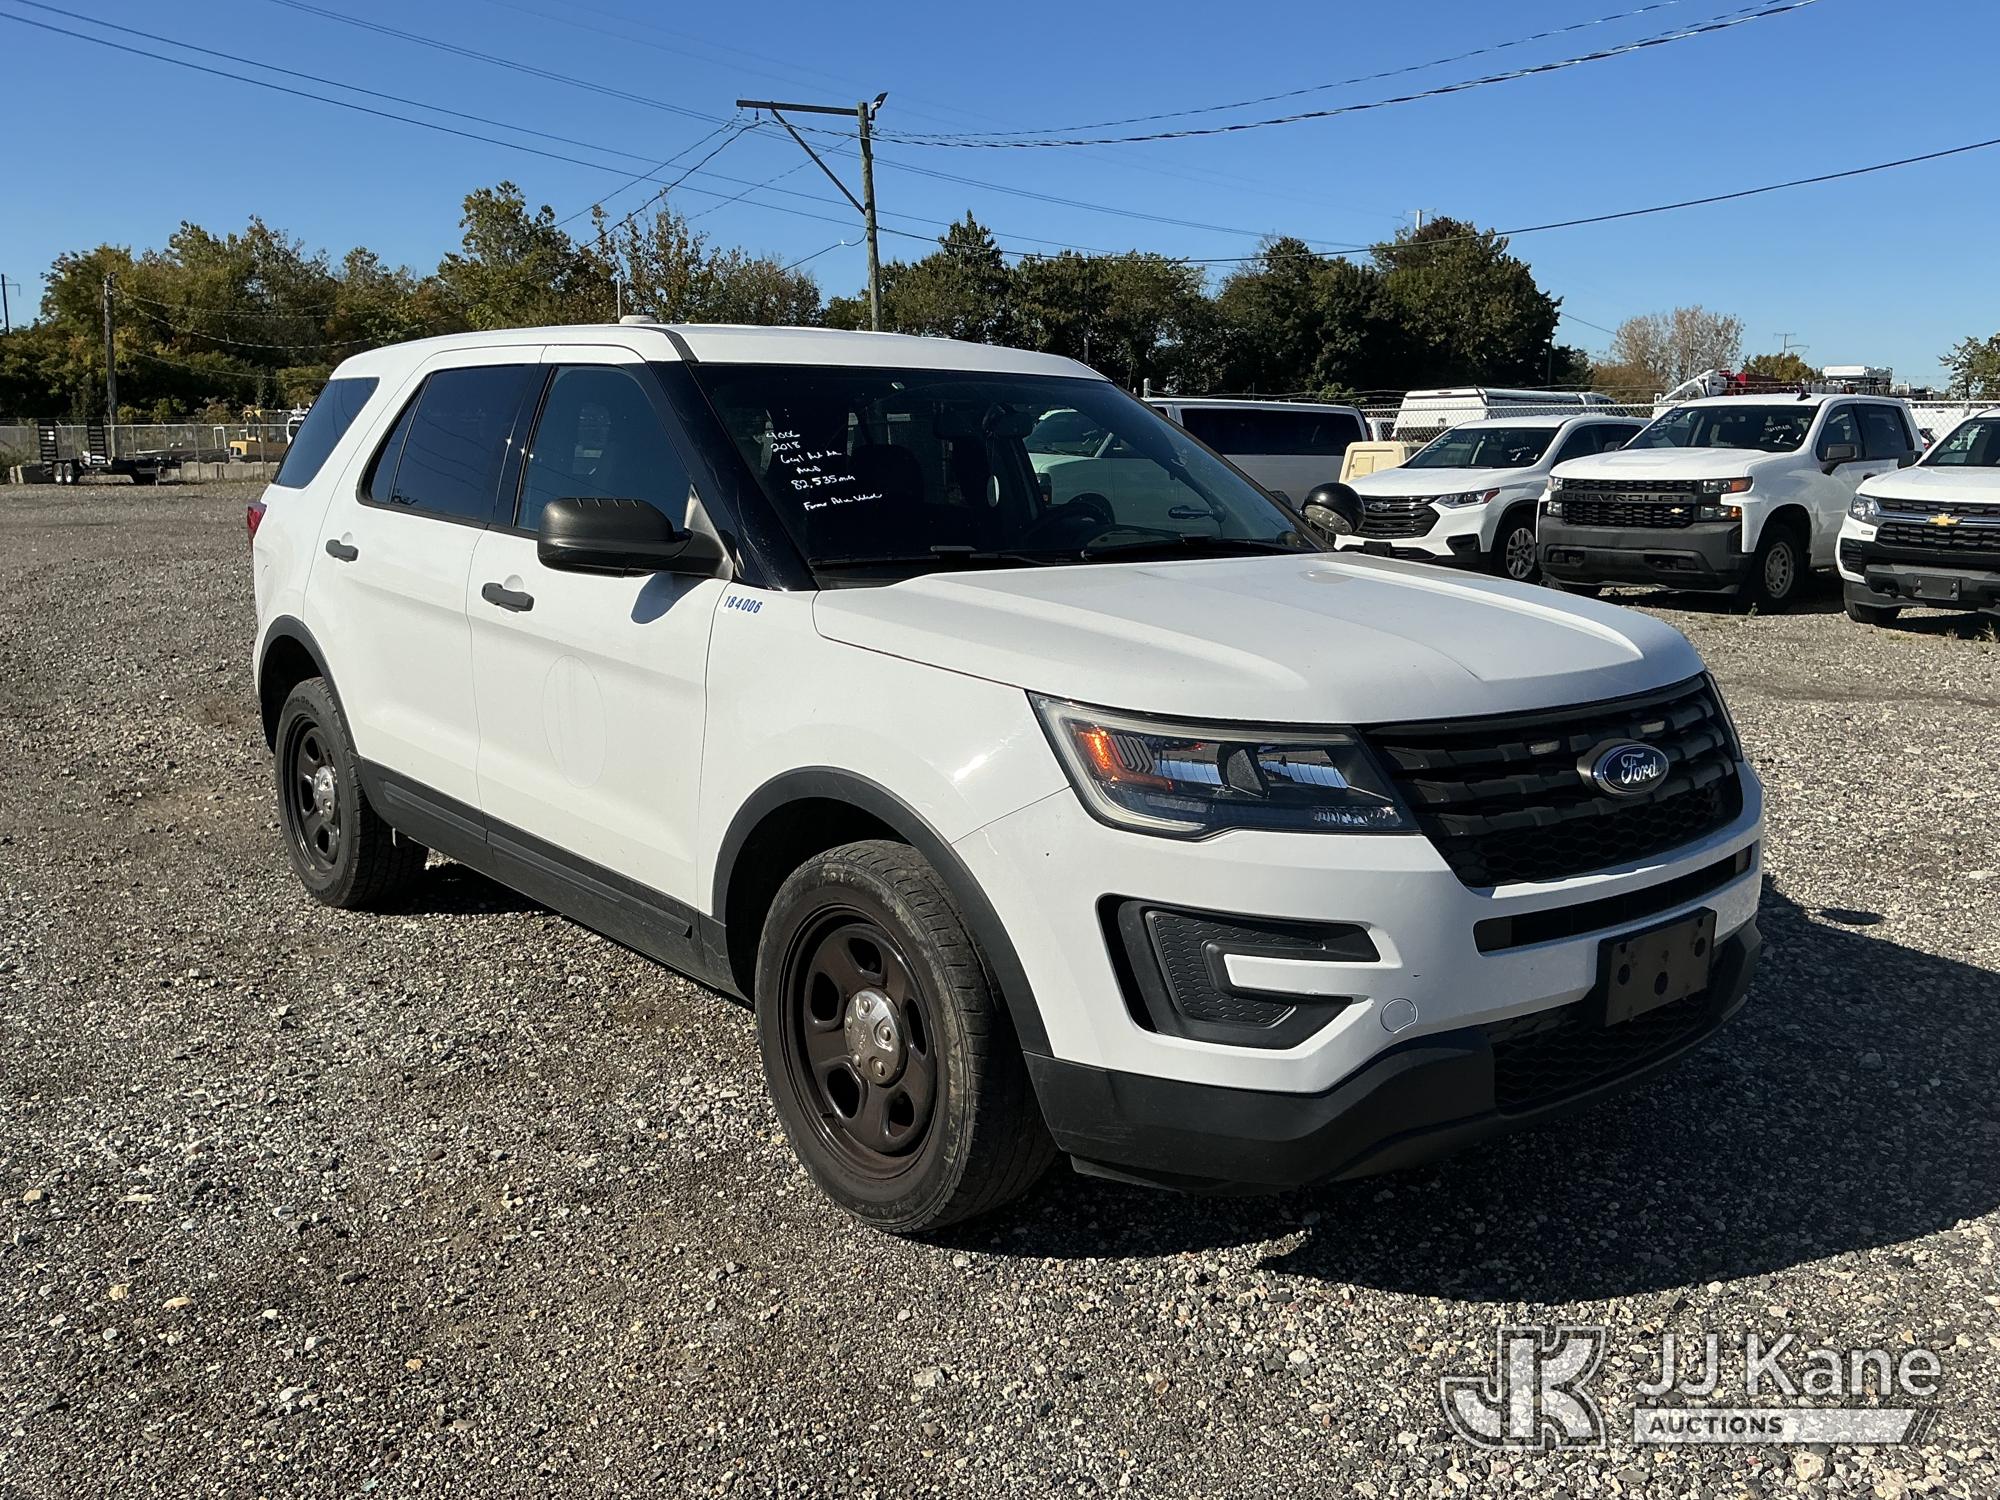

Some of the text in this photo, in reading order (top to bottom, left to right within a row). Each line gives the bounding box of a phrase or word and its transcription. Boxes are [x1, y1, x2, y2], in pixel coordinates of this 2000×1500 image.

[770, 441, 801, 452] 2018
[1562, 491, 1689, 503] CHEVROLET
[724, 596, 763, 613] 184006
[1621, 753, 1657, 784] Ford
